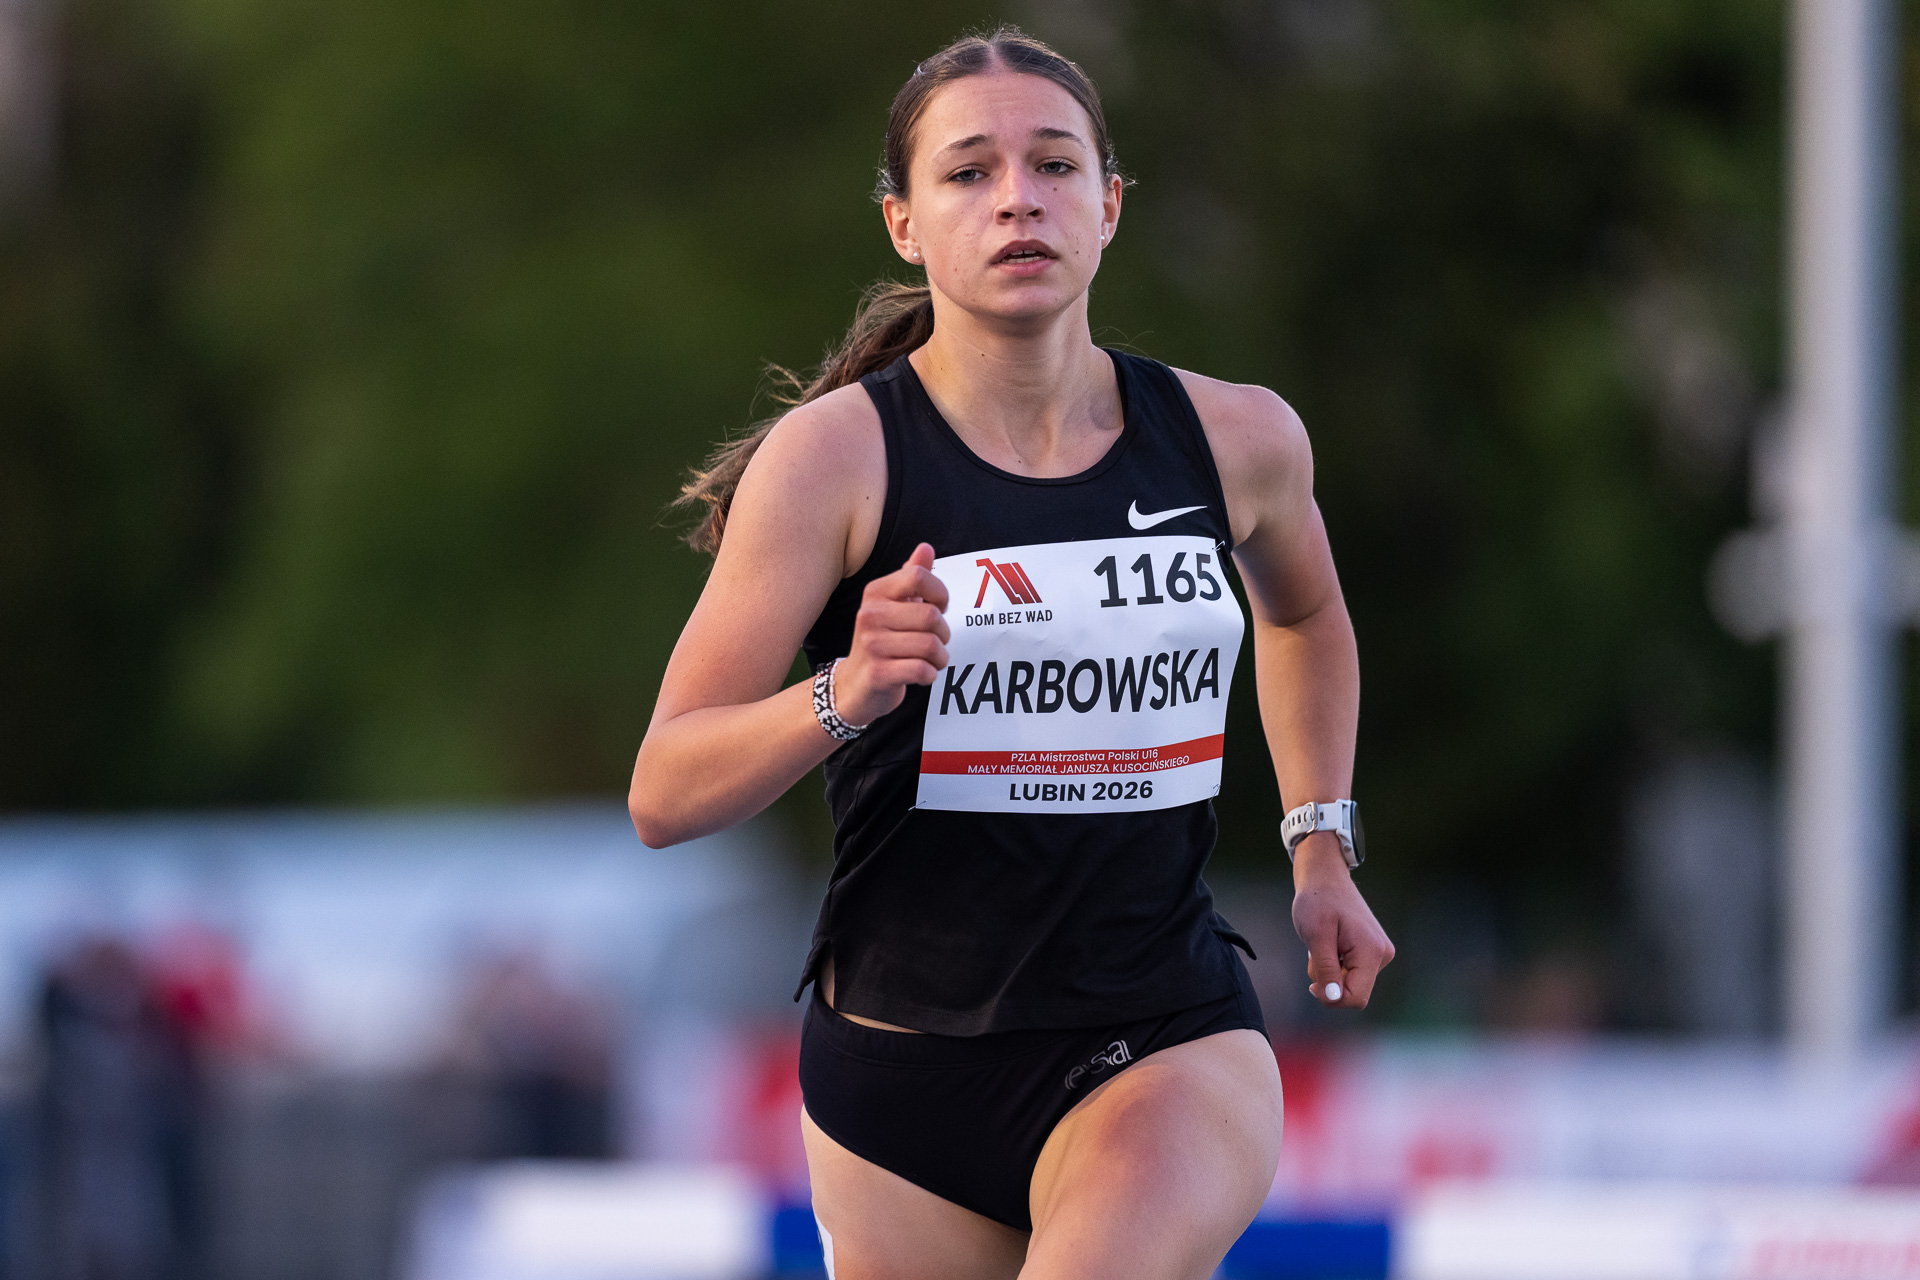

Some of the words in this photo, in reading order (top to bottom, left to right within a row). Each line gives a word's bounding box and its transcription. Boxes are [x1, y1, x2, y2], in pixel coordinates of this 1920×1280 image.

[1093, 551, 1222, 608] 1165
[965, 613, 995, 627] DOM
[998, 611, 1022, 625] BEZ
[1025, 609, 1053, 623] WAD
[939, 647, 1220, 715] KARBOWSKA
[967, 764, 998, 774] MAŁY
[1000, 764, 1058, 774] MEMORIAŁ
[1060, 763, 1110, 774] JANUSZA
[1112, 755, 1190, 773] KUSOCIŃSKIEGO
[1011, 753, 1037, 762] PZLA
[1039, 752, 1105, 762] Mistrzostwa
[1107, 750, 1140, 761] Polski
[1141, 748, 1159, 760] U16
[1009, 783, 1086, 801] LUBIN
[1091, 780, 1154, 801] 2026
